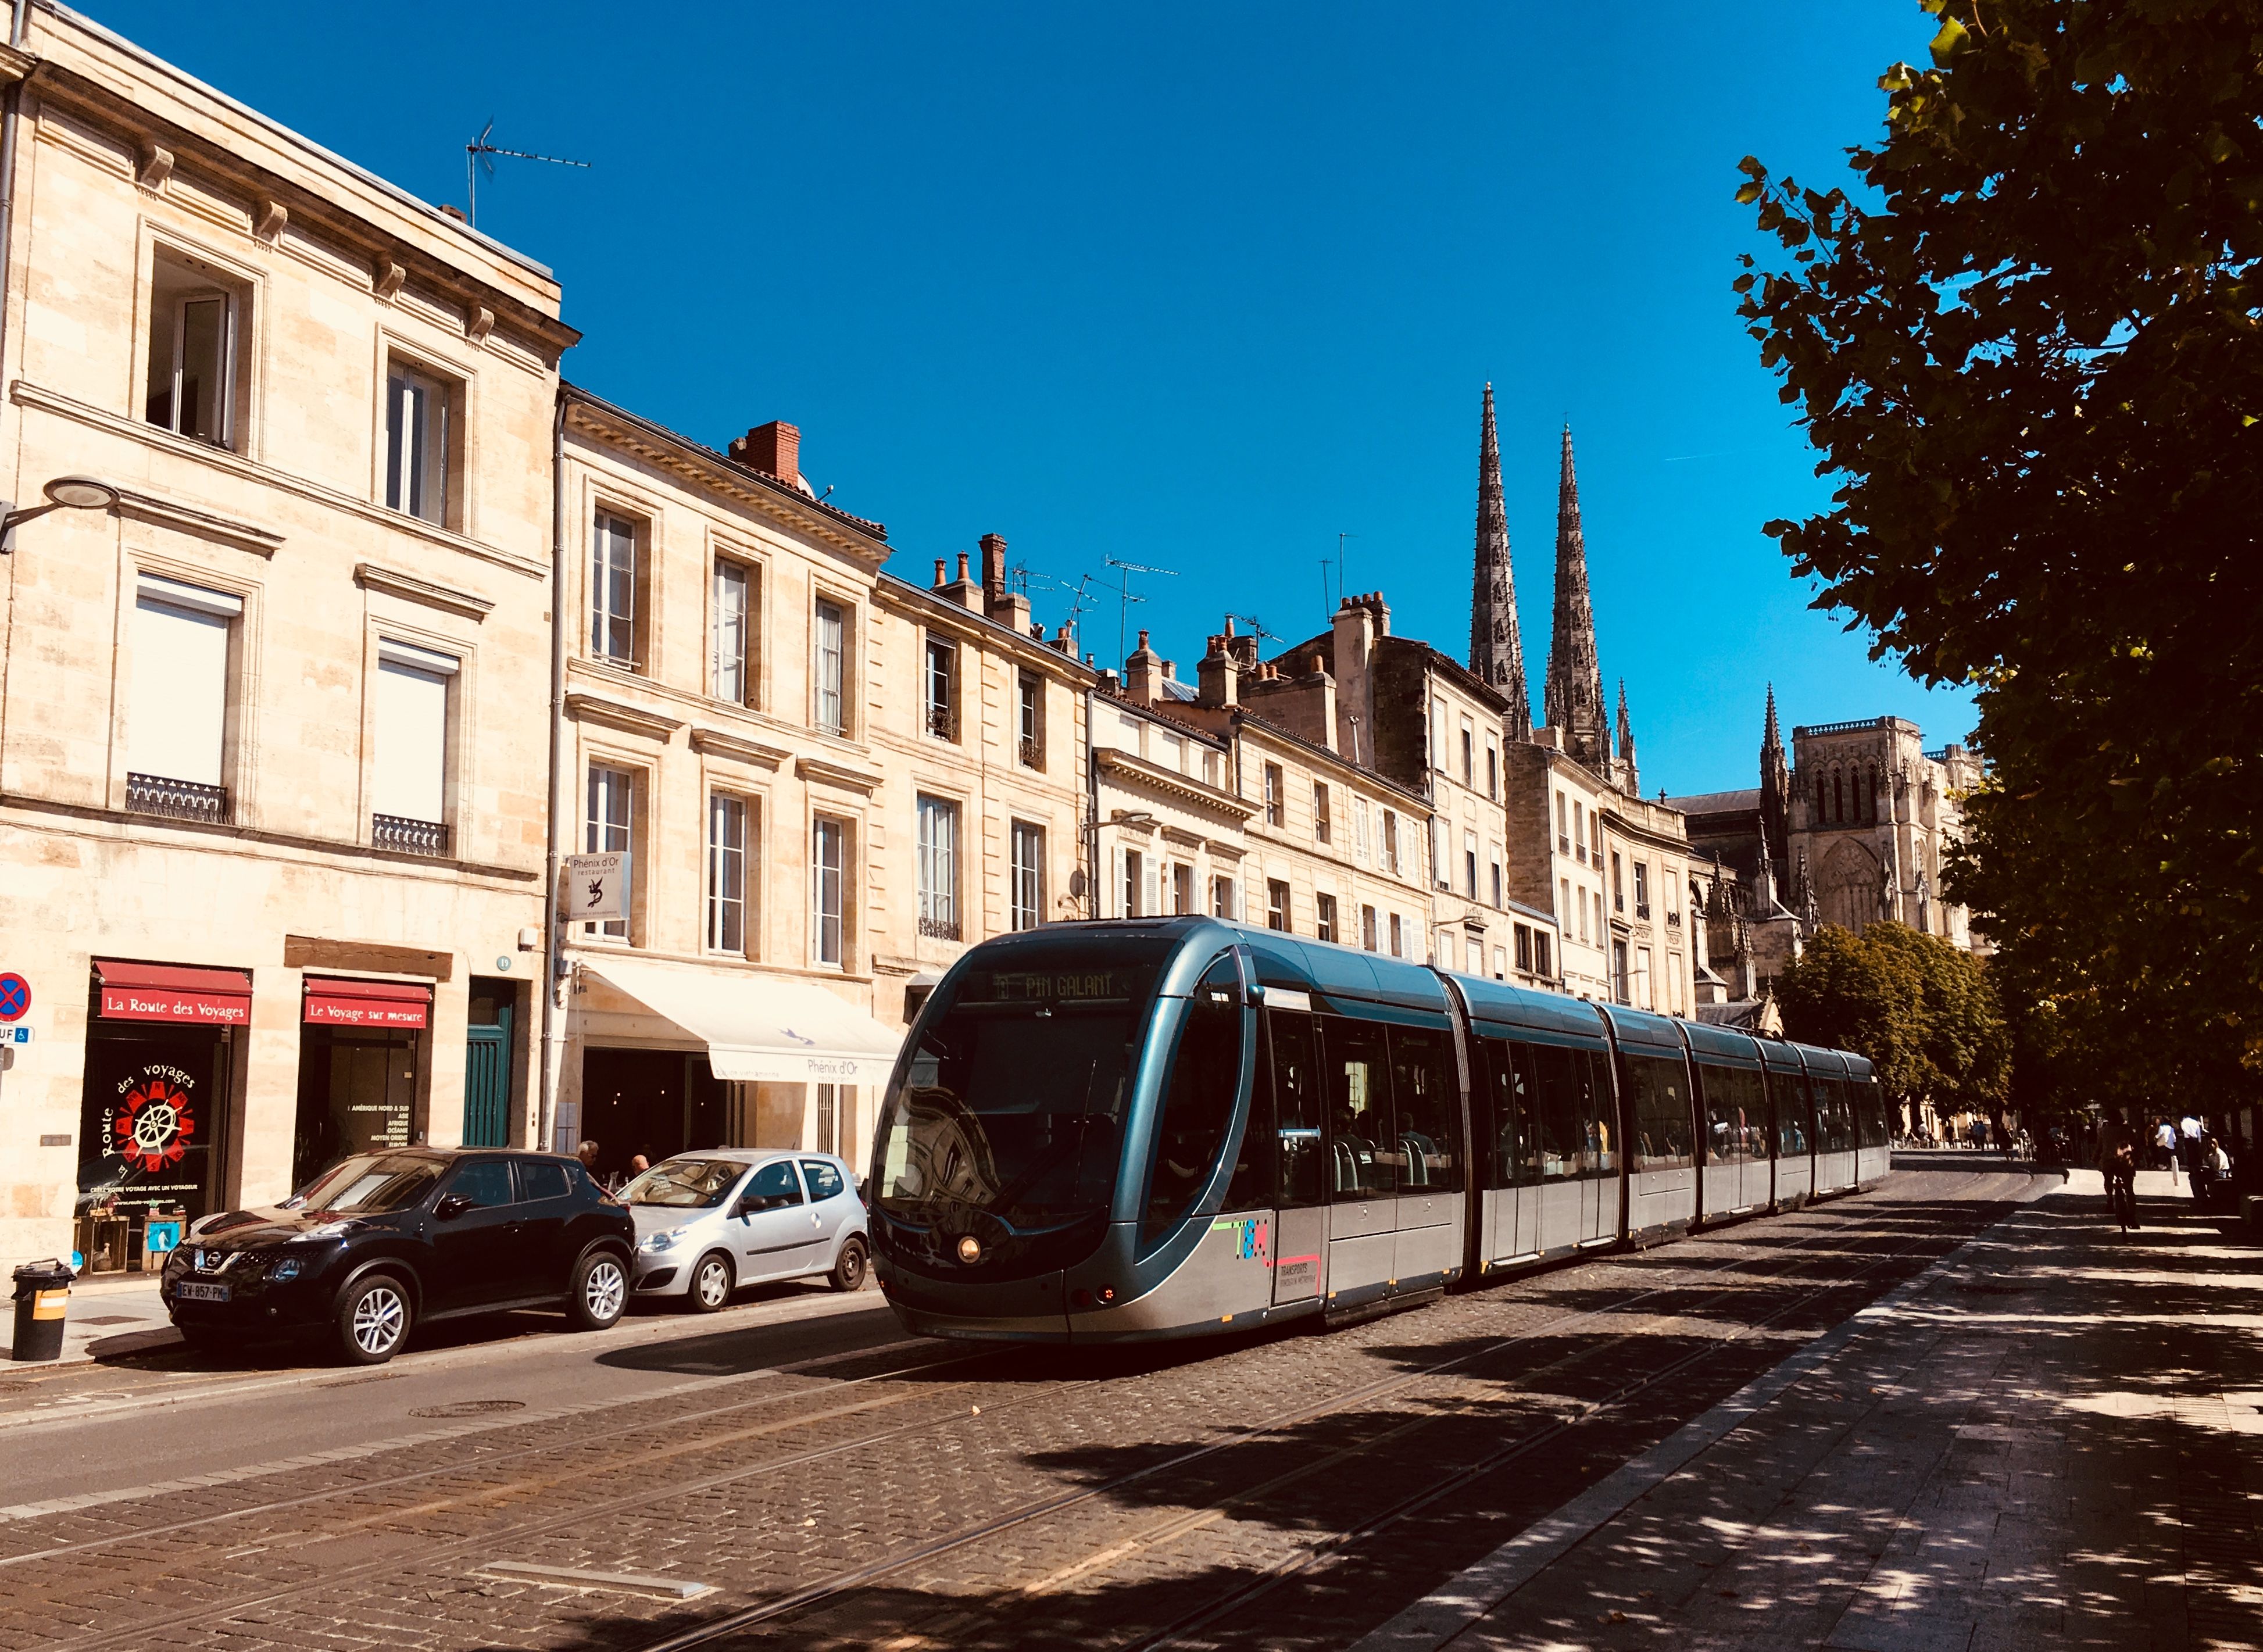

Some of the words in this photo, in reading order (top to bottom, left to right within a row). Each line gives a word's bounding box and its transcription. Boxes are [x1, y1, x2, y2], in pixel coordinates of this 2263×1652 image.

[574, 859, 600, 868] Phénix
[602, 857, 619, 867] d'Or
[501, 958, 509, 967] 19
[1026, 977, 1051, 997] PIN
[1057, 972, 1112, 996] GALANT
[107, 997, 124, 1011] La
[130, 998, 167, 1013] Route
[173, 1001, 193, 1015] des
[197, 1003, 244, 1021] Voyages
[310, 1004, 324, 1017] Le
[327, 1006, 363, 1022] Voyage
[368, 1010, 384, 1020] sur
[387, 1012, 423, 1022] mesure
[0, 1028, 13, 1039] UF
[808, 1059, 837, 1074] Phénix
[839, 1061, 858, 1075] d'Or
[101, 1108, 115, 1159] Route
[117, 1076, 134, 1093] des
[143, 1065, 195, 1088] voyages
[1213, 1218, 1268, 1260] TBM
